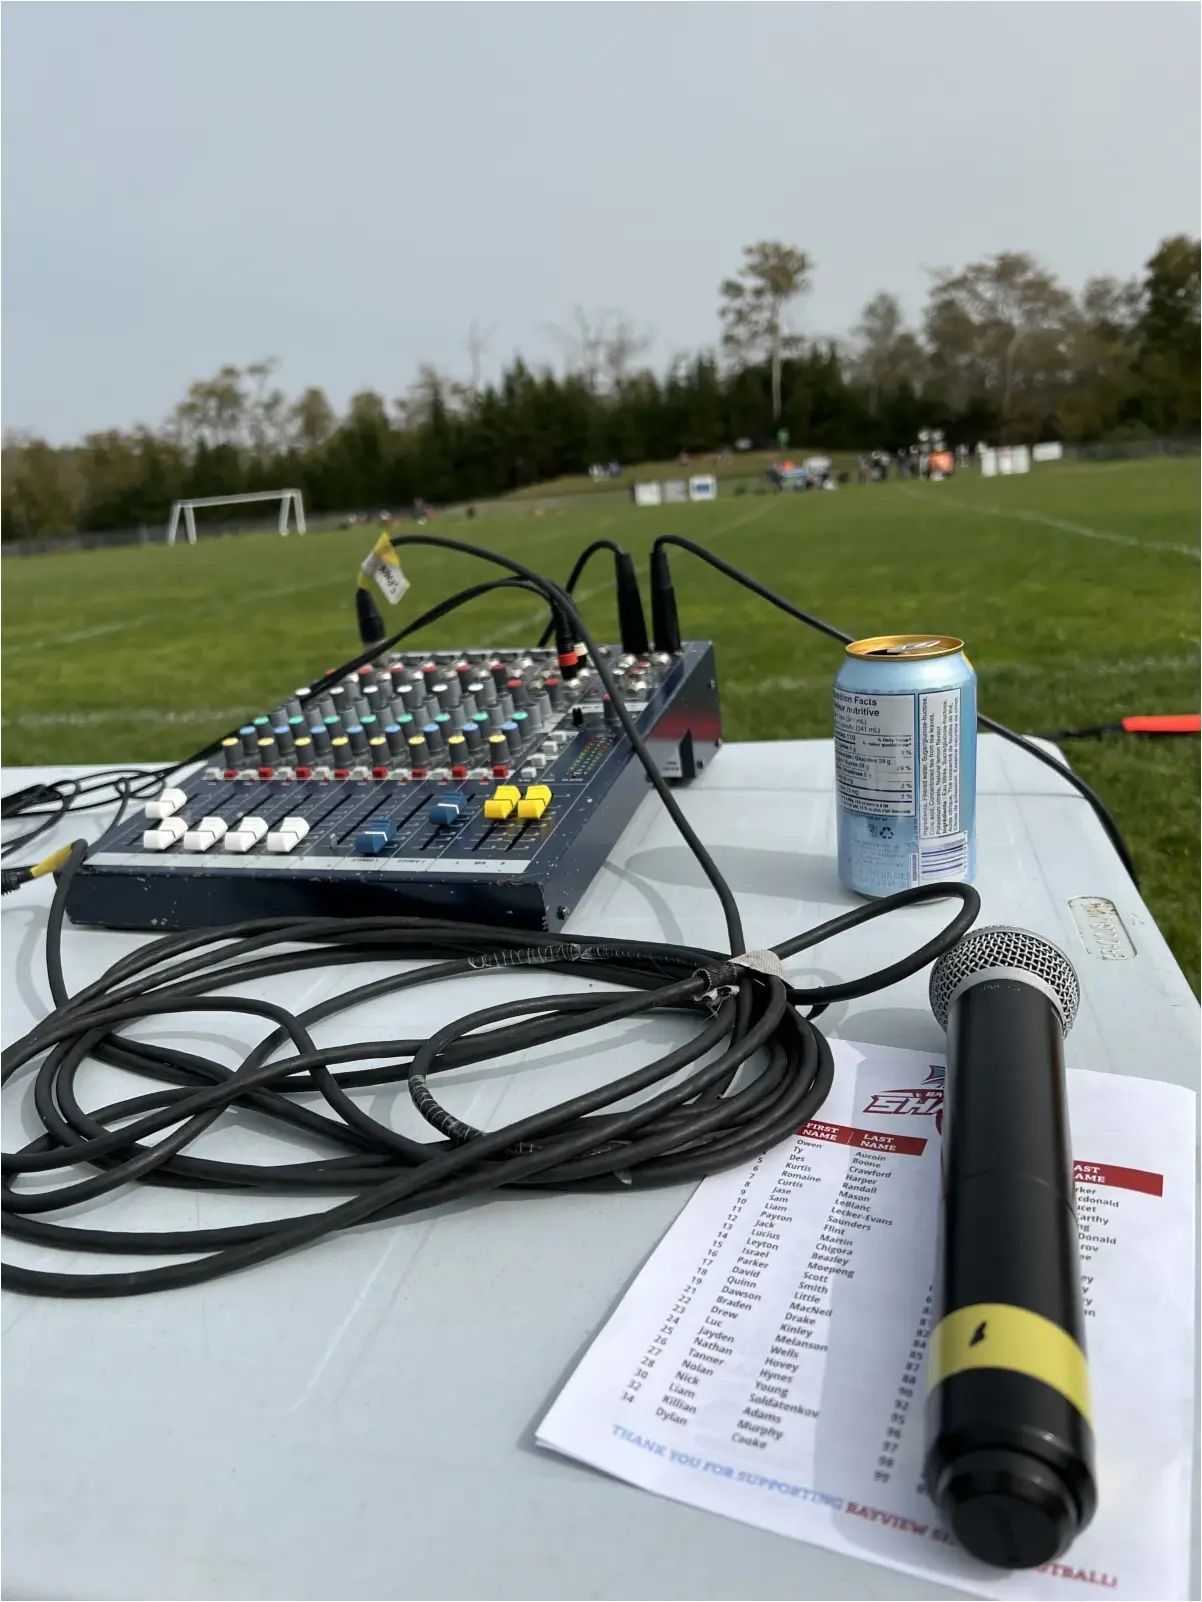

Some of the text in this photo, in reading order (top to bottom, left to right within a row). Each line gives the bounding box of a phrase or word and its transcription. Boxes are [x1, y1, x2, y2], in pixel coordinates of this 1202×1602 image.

[847, 708, 880, 716] nutritive
[854, 696, 877, 706] Facts
[802, 1129, 838, 1141] NAME
[805, 1122, 839, 1134] FIRST
[863, 1133, 895, 1144] LAST
[793, 1146, 881, 1169] Ty Boone
[797, 1139, 887, 1162] Owen Aucoin
[860, 1141, 897, 1151] NAME
[785, 1162, 812, 1172] Kurtis
[845, 1174, 878, 1186] Harper
[789, 1154, 892, 1178] Des Crawford
[1074, 1164, 1100, 1174] AST
[1074, 1173, 1105, 1183] AME
[777, 1179, 803, 1189] Curtis
[839, 1191, 870, 1202] Mason
[781, 1171, 821, 1183] Romaine
[842, 1183, 877, 1193] Randall
[1075, 1187, 1097, 1195] rker
[768, 1195, 789, 1204] Sam
[831, 1207, 893, 1226] Lecker-Evans
[772, 1187, 792, 1195] Jase
[835, 1199, 871, 1213] LeBlanc
[1078, 1196, 1119, 1208] cdonald
[728, 1214, 853, 1246] 12 Jack Martin
[760, 1211, 793, 1223] Payton
[823, 1224, 846, 1235] Flint
[764, 1203, 787, 1213] Liam
[827, 1216, 871, 1231] Saunders
[717, 1231, 849, 1266] 14 Leyton Beazley
[751, 1228, 781, 1240] Lucius
[815, 1243, 853, 1255] Chigora
[1078, 1233, 1117, 1245] Donald
[707, 1249, 828, 1283] 16 Parker Scott
[712, 1240, 855, 1279] 15 Israel Moepeng
[696, 1267, 821, 1304] 18 Quinn Little
[702, 1258, 828, 1294] 17 David Smith
[685, 1285, 816, 1325] 21 Braden Drake
[691, 1276, 833, 1317] 19 Dawson MacNeil
[672, 1304, 828, 1352] 23 Luc Melanson
[678, 1295, 813, 1338] 22 Drew Kinley
[661, 1324, 799, 1372] 25 Nathan Hovey
[666, 1314, 799, 1358] 24 Jayden Wells
[647, 1345, 789, 1398] 27 Nolan Young
[654, 1335, 793, 1384] 26 Tanner Hynes
[668, 1383, 696, 1399] Liam
[743, 1406, 782, 1424] Adams
[675, 1371, 700, 1385] Nick
[749, 1393, 820, 1419] Soldatenkov
[656, 1407, 688, 1427] Dylan
[662, 1394, 697, 1414] Killian
[737, 1420, 784, 1441] Murphy
[611, 1424, 668, 1457] THANK
[669, 1450, 701, 1469] YOU
[703, 1457, 734, 1478] FOR
